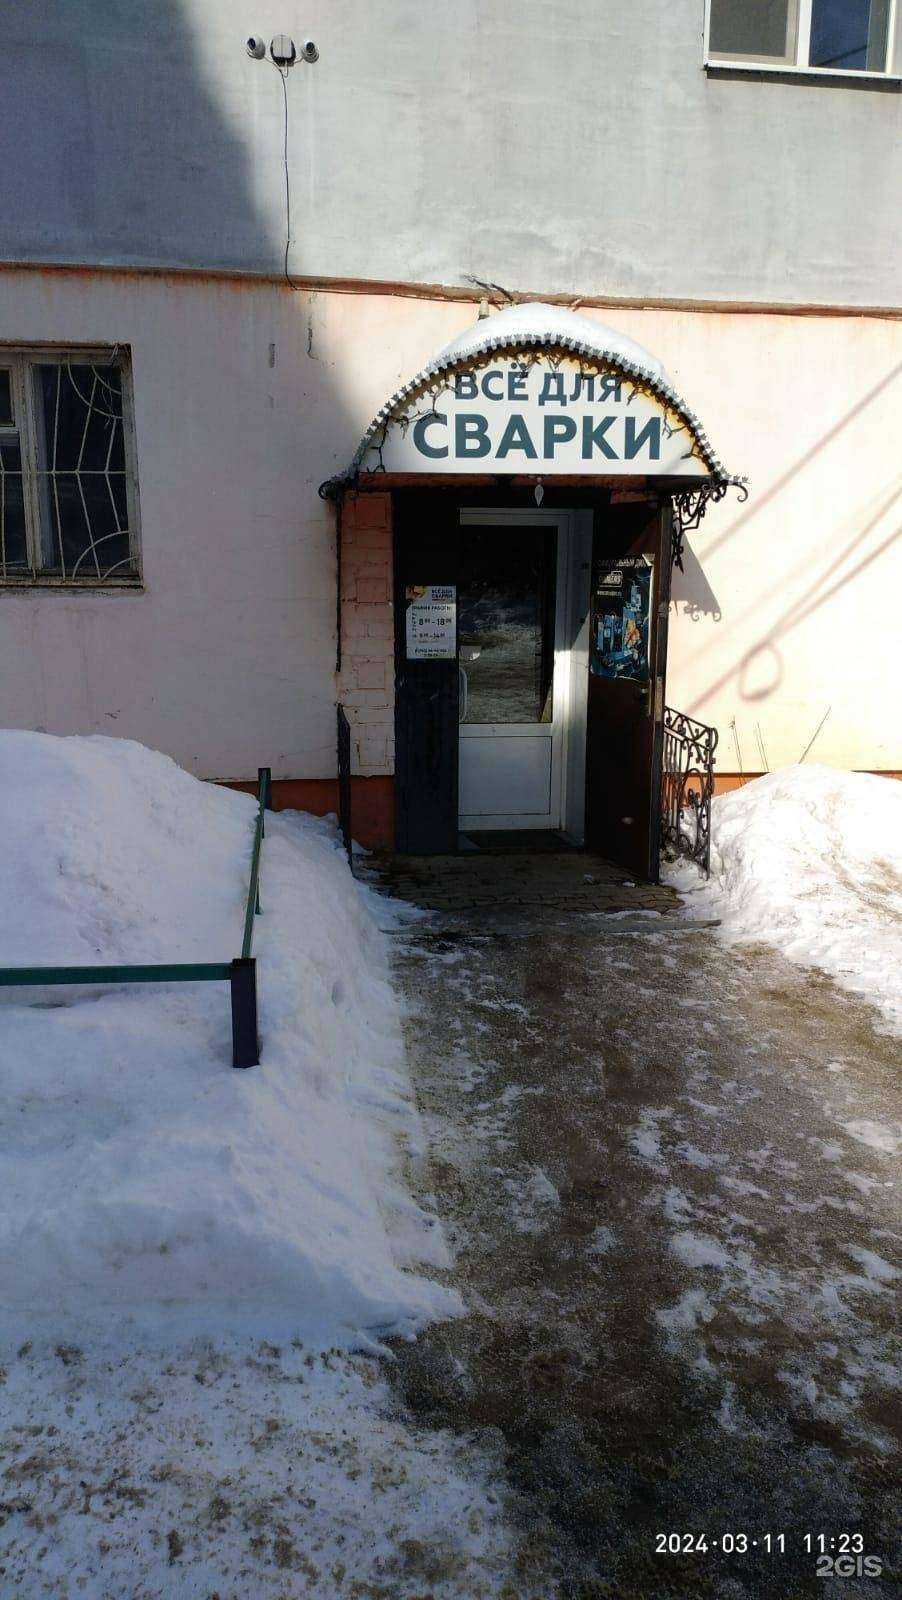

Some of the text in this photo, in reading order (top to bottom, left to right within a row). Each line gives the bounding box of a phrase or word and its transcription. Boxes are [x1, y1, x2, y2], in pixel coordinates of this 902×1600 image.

[455, 362, 622, 407] ВСЁ ДЛЯ
[413, 413, 661, 460] СВАРКИ
